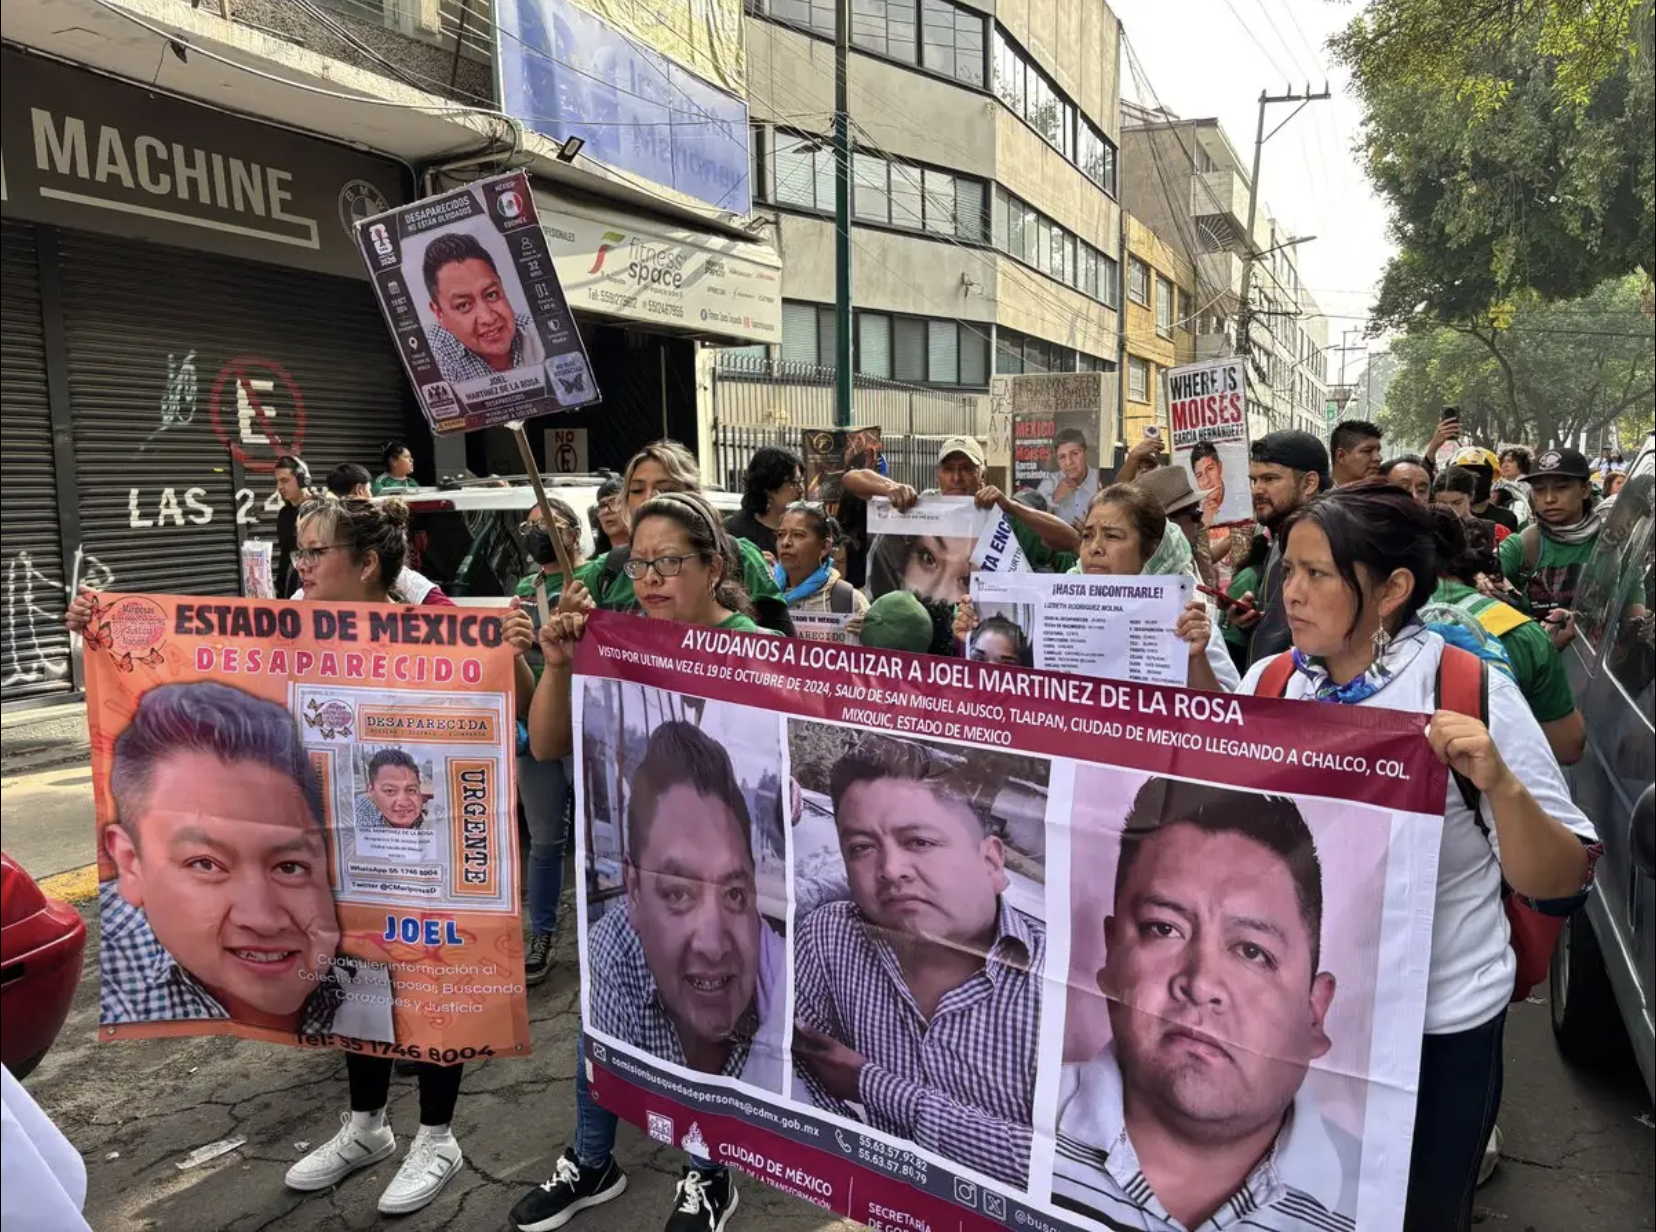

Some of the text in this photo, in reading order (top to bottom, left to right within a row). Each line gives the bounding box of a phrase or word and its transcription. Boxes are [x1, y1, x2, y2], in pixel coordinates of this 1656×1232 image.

[31, 107, 293, 222] MACHINE
[404, 195, 471, 224] DESAPARECIDOS
[407, 223, 417, 233] NO
[437, 206, 472, 223] OLVIDADOS
[528, 261, 539, 271] 32
[628, 236, 684, 271] fitness
[628, 261, 683, 289] space
[465, 378, 540, 400] MARTINEZ DE LA ROSA
[489, 375, 507, 387] JOEL
[1170, 366, 1237, 400] WHERE IS
[1171, 391, 1242, 432] MOISÉS
[554, 431, 575, 443] NO
[129, 487, 214, 528] LAS
[1052, 582, 1164, 600] ¡HASTA ENCONTRARLE!
[1101, 604, 1124, 612] MOLINA
[175, 604, 302, 640] ESTADO
[313, 609, 358, 642] DE
[369, 606, 503, 648] MÉXICO
[195, 645, 483, 684] DESAPARECIDO
[681, 629, 1244, 726] AYUDANOS A LOCALIZAR A JOEL MARTINEZ DE LA ROSA
[366, 716, 487, 730] DESAPARECIDA
[598, 644, 1411, 780] VISTO POR ULTIMA VEZ EL 19 DE OCTUBRE DE 2024, SALIO DE SAN MIGUEL AJUSCO, TLALPAN, CIUDAD DE MEXICO LLEGANDO A CHALCO, COL.
[842, 707, 1012, 746] MIXQUIC, ESTADO DE MEXICO
[459, 768, 488, 885] URGENTE
[350, 864, 388, 874] WhatsApp
[351, 881, 378, 889] Twitter
[384, 915, 464, 946] JOEL
[317, 953, 497, 975] Cualquier información al
[298, 968, 523, 995] Colectivo Mariposas Buscando
[335, 989, 483, 1014] Corazones y Justicia
[297, 1032, 496, 1064] Tel: 55 1746 8004
[611, 1056, 820, 1137] comisionbusquedadepersonas@cdmx.gob.mx
[857, 1148, 928, 1185] 55.63.57.80.79
[858, 1134, 929, 1172] 55.63.57.92.82
[718, 1143, 833, 1196] CIUDAD DE MÉXICO
[765, 1176, 831, 1210] TRANSFORMACIÓN
[868, 1202, 932, 1232] SECRETARÍA
